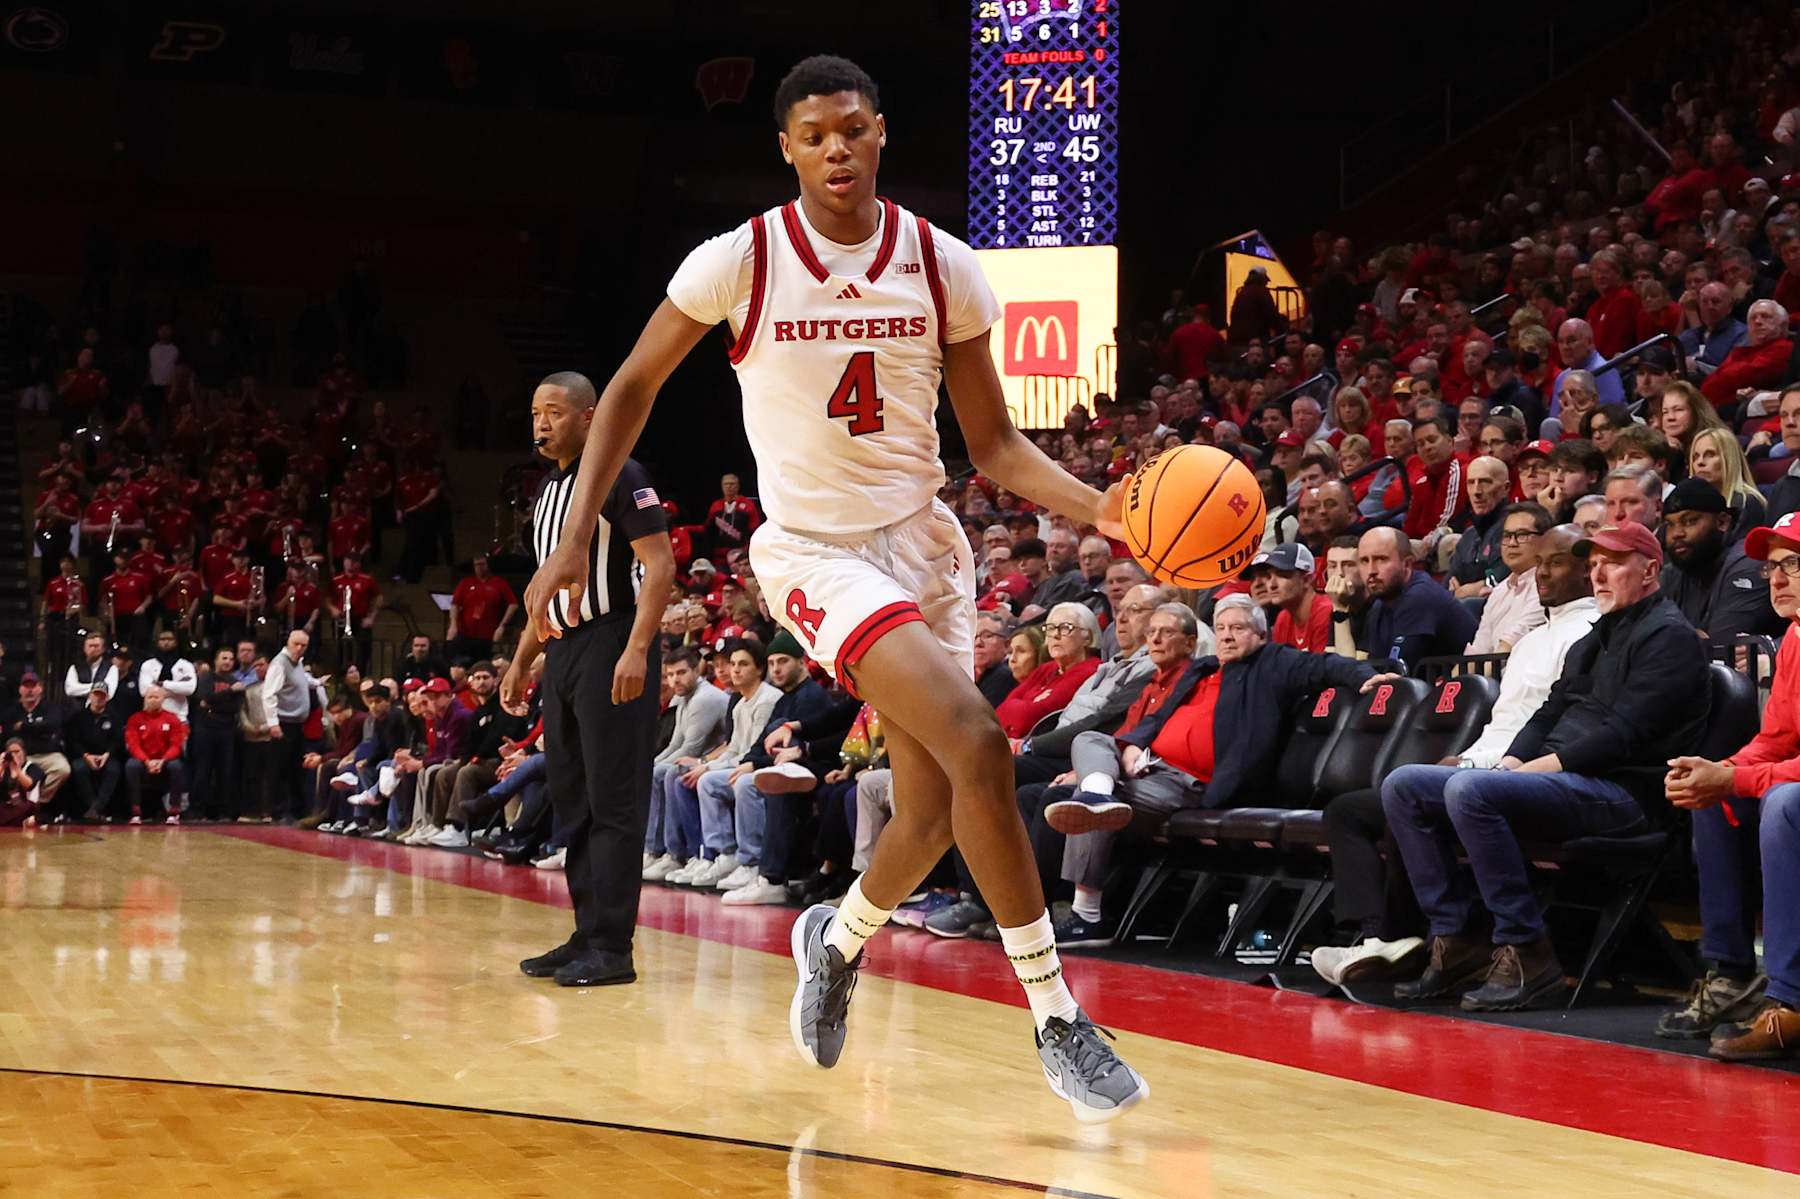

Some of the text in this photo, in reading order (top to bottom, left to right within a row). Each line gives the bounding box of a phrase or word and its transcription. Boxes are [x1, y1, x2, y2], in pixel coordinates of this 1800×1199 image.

[979, 2, 1000, 18] 25
[1007, 0, 1028, 17] 13
[1039, 0, 1051, 15] 3
[1067, 0, 1079, 14] 2
[980, 21, 1107, 43] 31 5 6 1 1
[1004, 48, 1105, 65] TEAM FOULS 0
[998, 75, 1096, 112] 17:41
[994, 113, 1101, 134] RU UW
[990, 136, 1100, 166] 37 2ND 45
[995, 170, 1095, 187] 18 REB 21
[997, 186, 1091, 201] 3 BLK 3
[997, 201, 1091, 217] 3 STL 3
[1031, 220, 1058, 232] AST
[1080, 217, 1095, 228] 12
[996, 232, 1091, 247] 4 TURN 7
[774, 316, 927, 342] RUTGERS
[827, 351, 885, 437] 4
[1227, 493, 1249, 518] R
[786, 588, 827, 649] R
[1312, 687, 1336, 717] R
[1369, 684, 1393, 715] R
[1435, 682, 1461, 713] R
